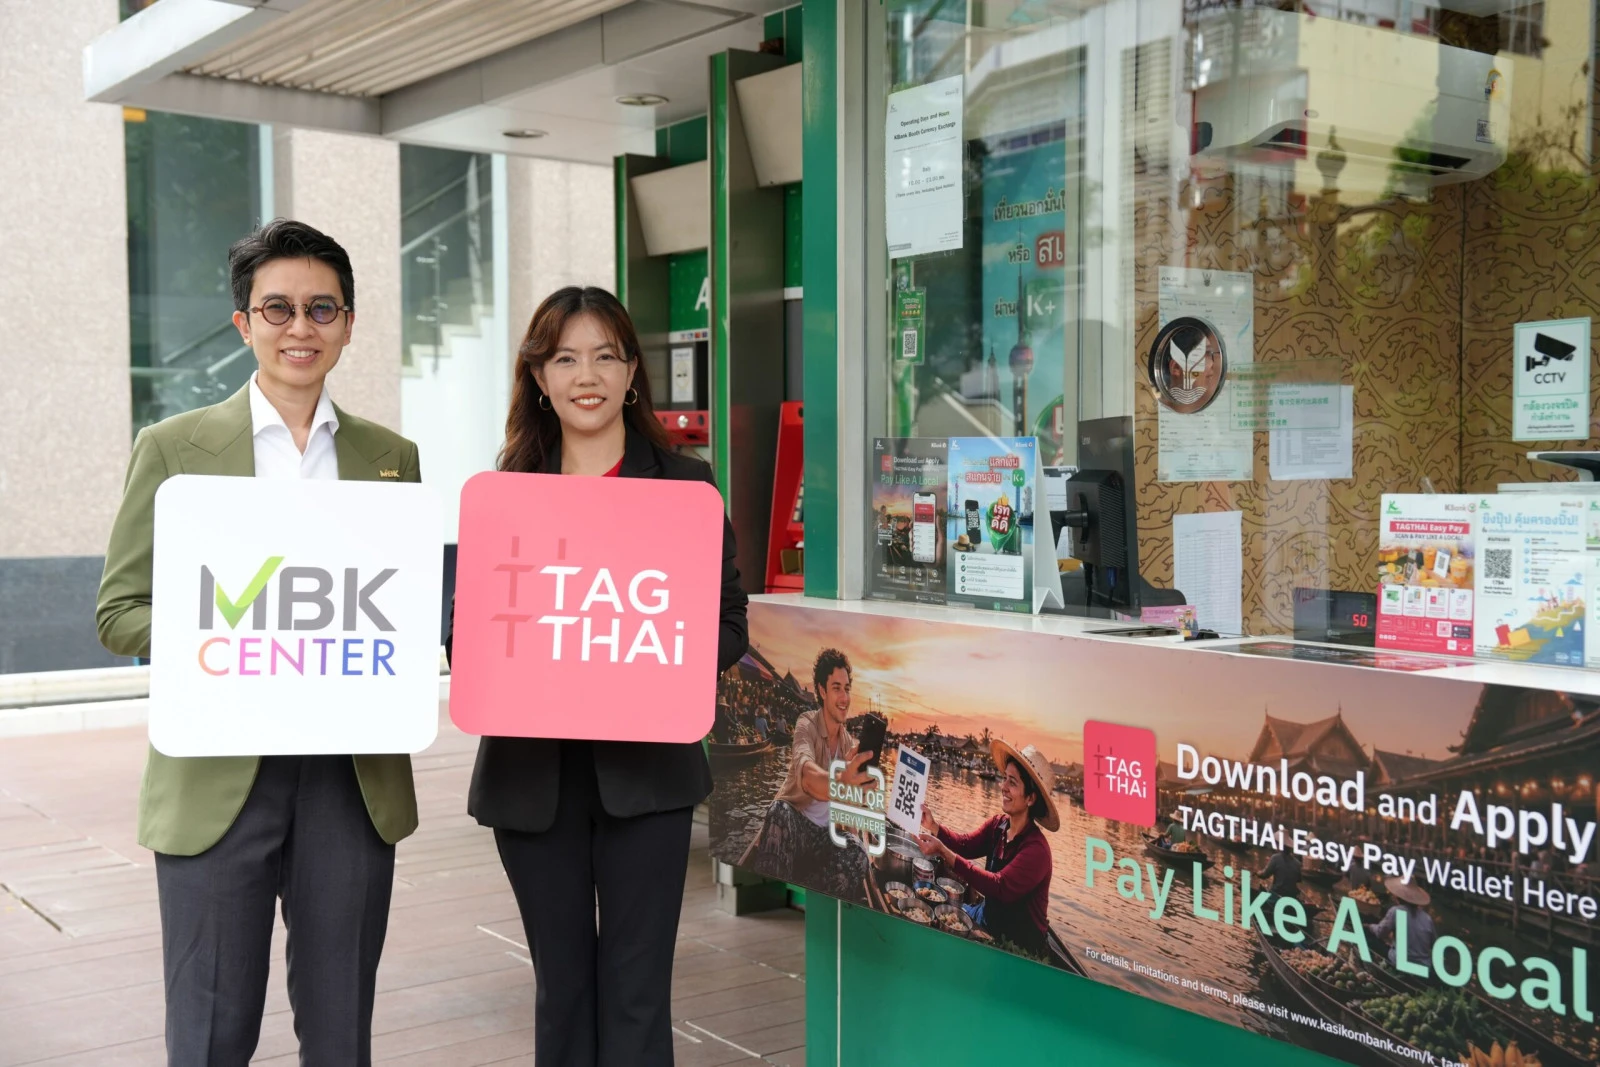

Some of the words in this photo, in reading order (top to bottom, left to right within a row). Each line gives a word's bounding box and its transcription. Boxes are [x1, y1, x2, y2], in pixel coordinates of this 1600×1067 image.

[901, 118, 919, 127] Operating
[921, 126, 937, 135] Currency
[938, 121, 956, 130] Exchange
[1027, 294, 1056, 317] K+
[1534, 372, 1566, 384] CCTV
[893, 456, 917, 464] Download
[925, 457, 939, 465] Apply
[881, 474, 894, 486] Pay
[895, 474, 910, 485] Like
[911, 475, 917, 485] A
[919, 475, 939, 486] Local
[1430, 524, 1447, 533] Easy
[1449, 525, 1464, 533] Pay
[199, 556, 399, 631] MBK
[540, 565, 669, 614] TAG
[1353, 613, 1368, 627] 50
[198, 637, 396, 676] CENTER
[1105, 756, 1142, 778] TAG
[830, 782, 863, 804] SCAN
[866, 790, 884, 810] QR
[1105, 774, 1147, 798] THAi
[1177, 743, 1365, 812] Download
[1378, 793, 1437, 825] and
[1450, 790, 1597, 865] Apply
[830, 810, 885, 834] EVERYWHERE
[1178, 805, 1285, 851] TAGTHAi
[1293, 828, 1355, 872] Easy
[1363, 842, 1416, 885] Pay
[1423, 857, 1514, 902] Wallet
[1522, 877, 1597, 920] Here
[1085, 836, 1175, 920] Pay
[1193, 861, 1307, 944] Like
[1326, 896, 1373, 964] A
[1396, 908, 1594, 1024] Local
[1086, 947, 1100, 959] For
[1101, 952, 1132, 971] details,
[1133, 960, 1179, 985] limitations
[1181, 978, 1199, 991] and
[1200, 982, 1231, 1003] terms,
[1233, 993, 1265, 1012] please
[1267, 1002, 1288, 1019] visit
